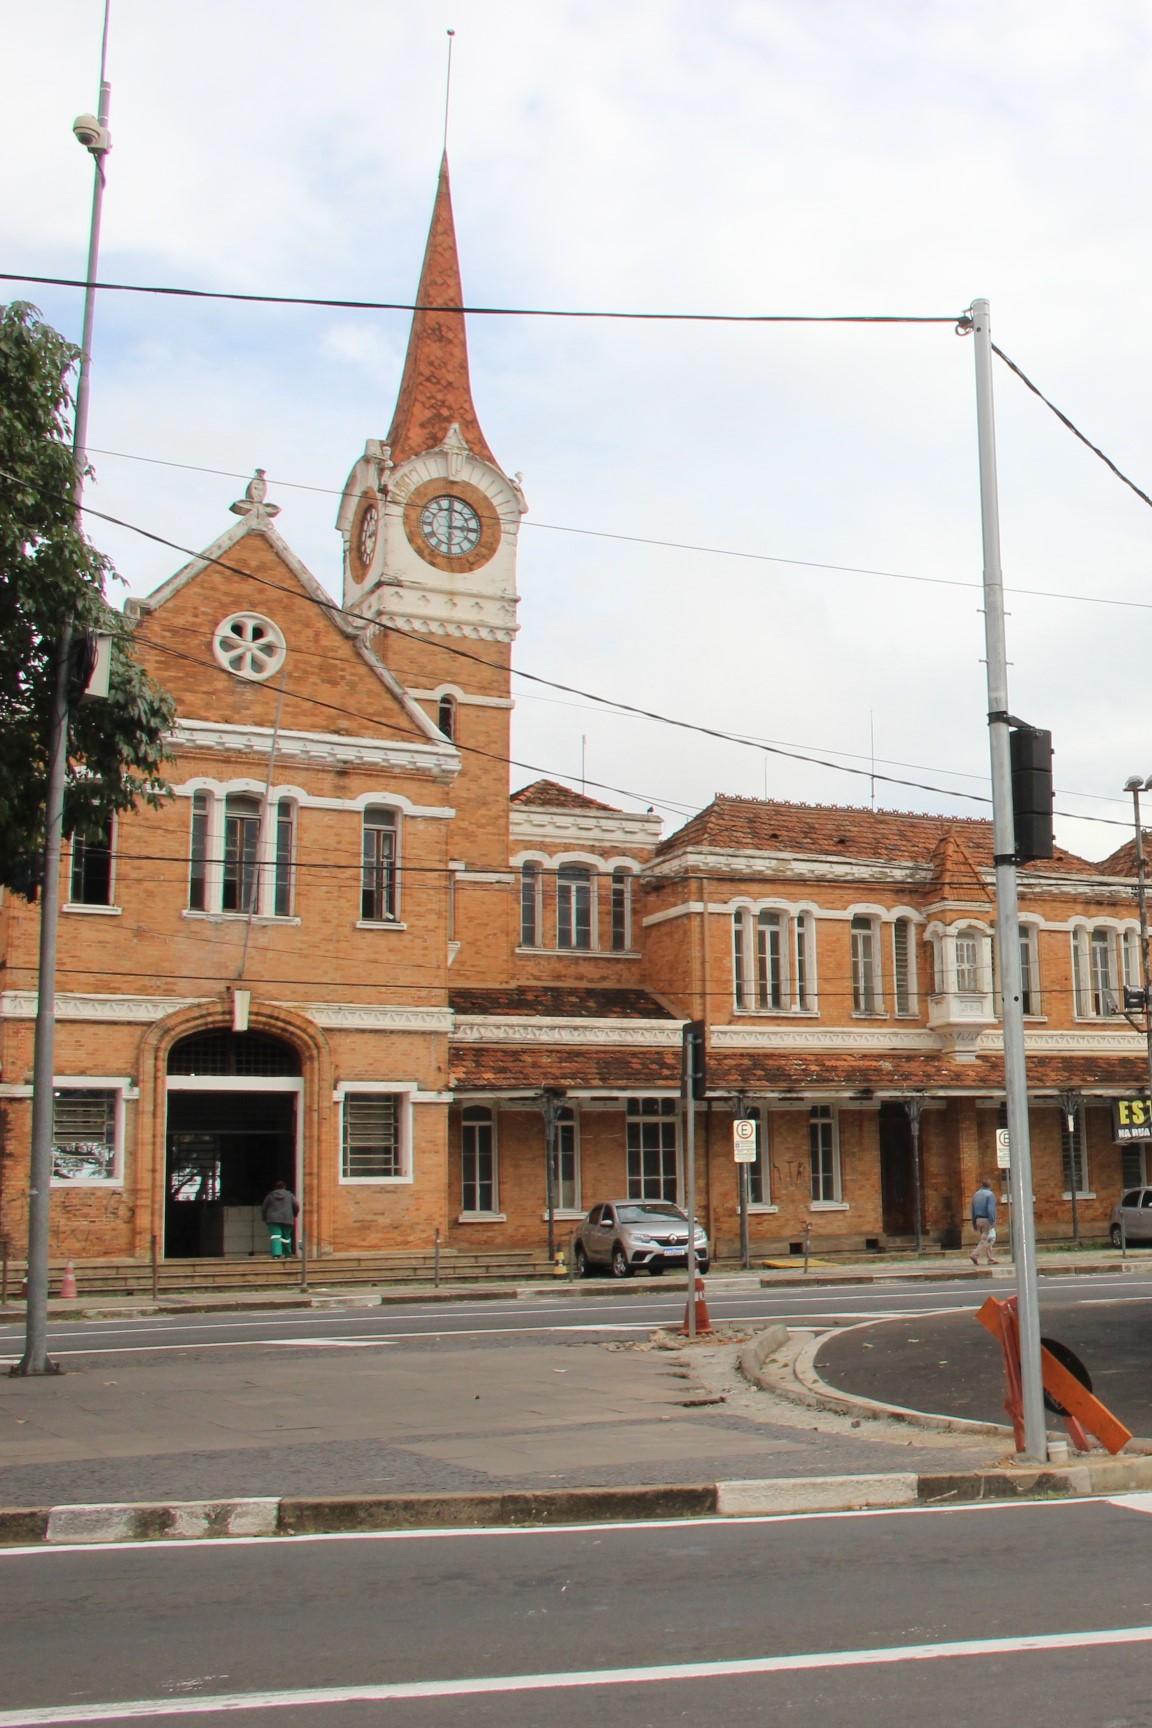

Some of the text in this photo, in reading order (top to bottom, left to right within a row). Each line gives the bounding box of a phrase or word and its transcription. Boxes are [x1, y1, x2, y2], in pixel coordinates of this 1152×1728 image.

[741, 1124, 748, 1136] E
[1118, 1128, 1132, 1138] NA
[1132, 1127, 1151, 1137] RUA
